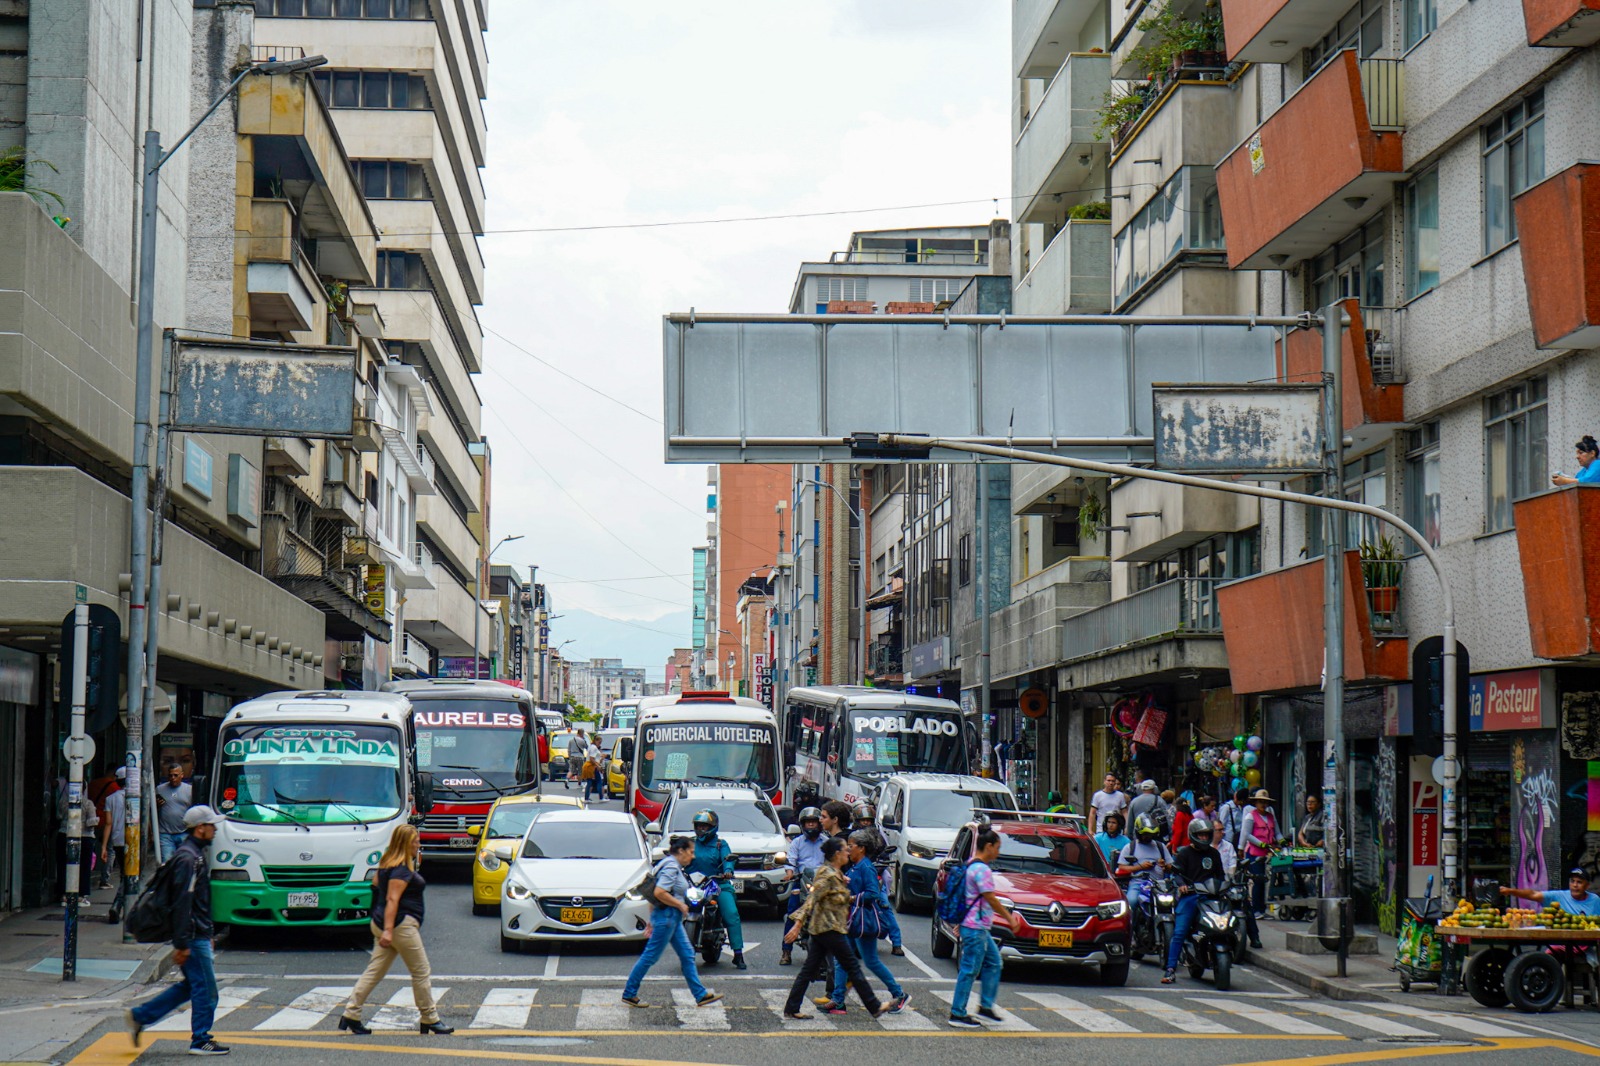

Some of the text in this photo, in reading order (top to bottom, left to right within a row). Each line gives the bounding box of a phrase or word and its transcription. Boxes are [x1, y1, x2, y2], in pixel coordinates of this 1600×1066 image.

[755, 656, 763, 702] HOTEL
[763, 668, 771, 703] HOTE
[1469, 681, 1538, 717] ia Pasteur
[413, 712, 526, 728] AURELES
[854, 717, 958, 737] POBLADO
[646, 726, 772, 744] COMERCIAL HOTELERA
[224, 737, 316, 756] QUINTA
[322, 738, 396, 757] LINDA
[442, 778, 483, 786] CENTRO
[658, 783, 678, 791] SAN
[844, 793, 857, 804] 50
[1421, 814, 1429, 865] Pasteur
[216, 850, 250, 867] 05
[366, 850, 384, 866] 0
[562, 910, 592, 919] GEX-657
[1040, 933, 1071, 943] KTY-374
